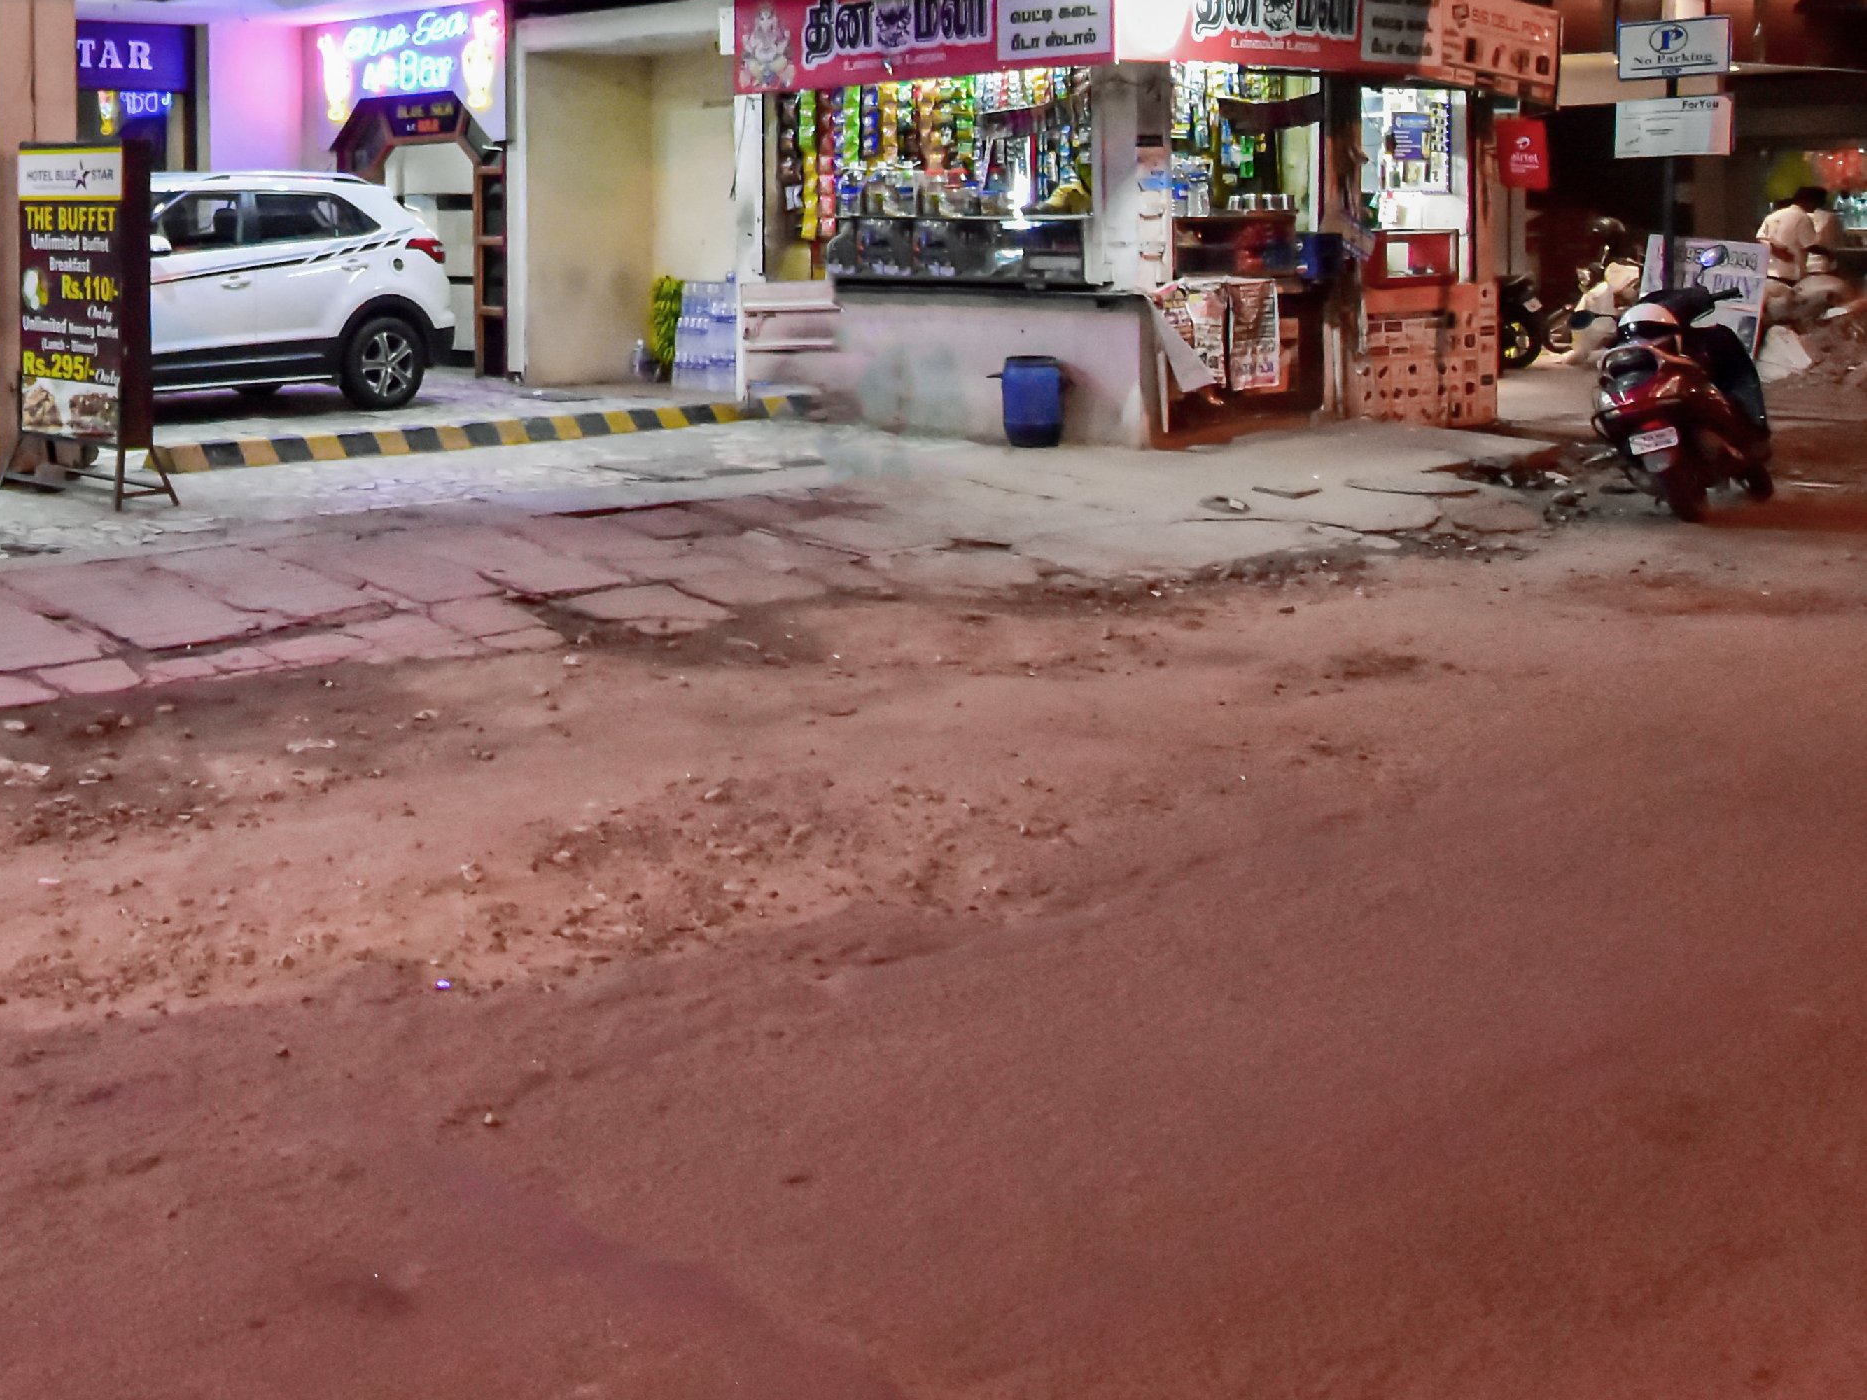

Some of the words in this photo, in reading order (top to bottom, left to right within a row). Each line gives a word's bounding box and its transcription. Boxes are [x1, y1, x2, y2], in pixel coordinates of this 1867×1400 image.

[412, 11, 469, 46] Sea
[77, 39, 154, 70] TAR
[1634, 56, 1652, 65] No
[1657, 52, 1714, 65] Parking
[399, 50, 453, 91] Bar
[27, 169, 53, 181] HOTEL
[55, 169, 77, 181] BLUE
[91, 167, 114, 180] STAR
[25, 206, 53, 231] THE
[58, 206, 117, 232] BUFFET
[31, 233, 80, 251] Unlimited
[49, 256, 90, 273] Breakfast
[61, 274, 119, 302] Rs.110/-
[23, 350, 95, 380] Rs.295/-
